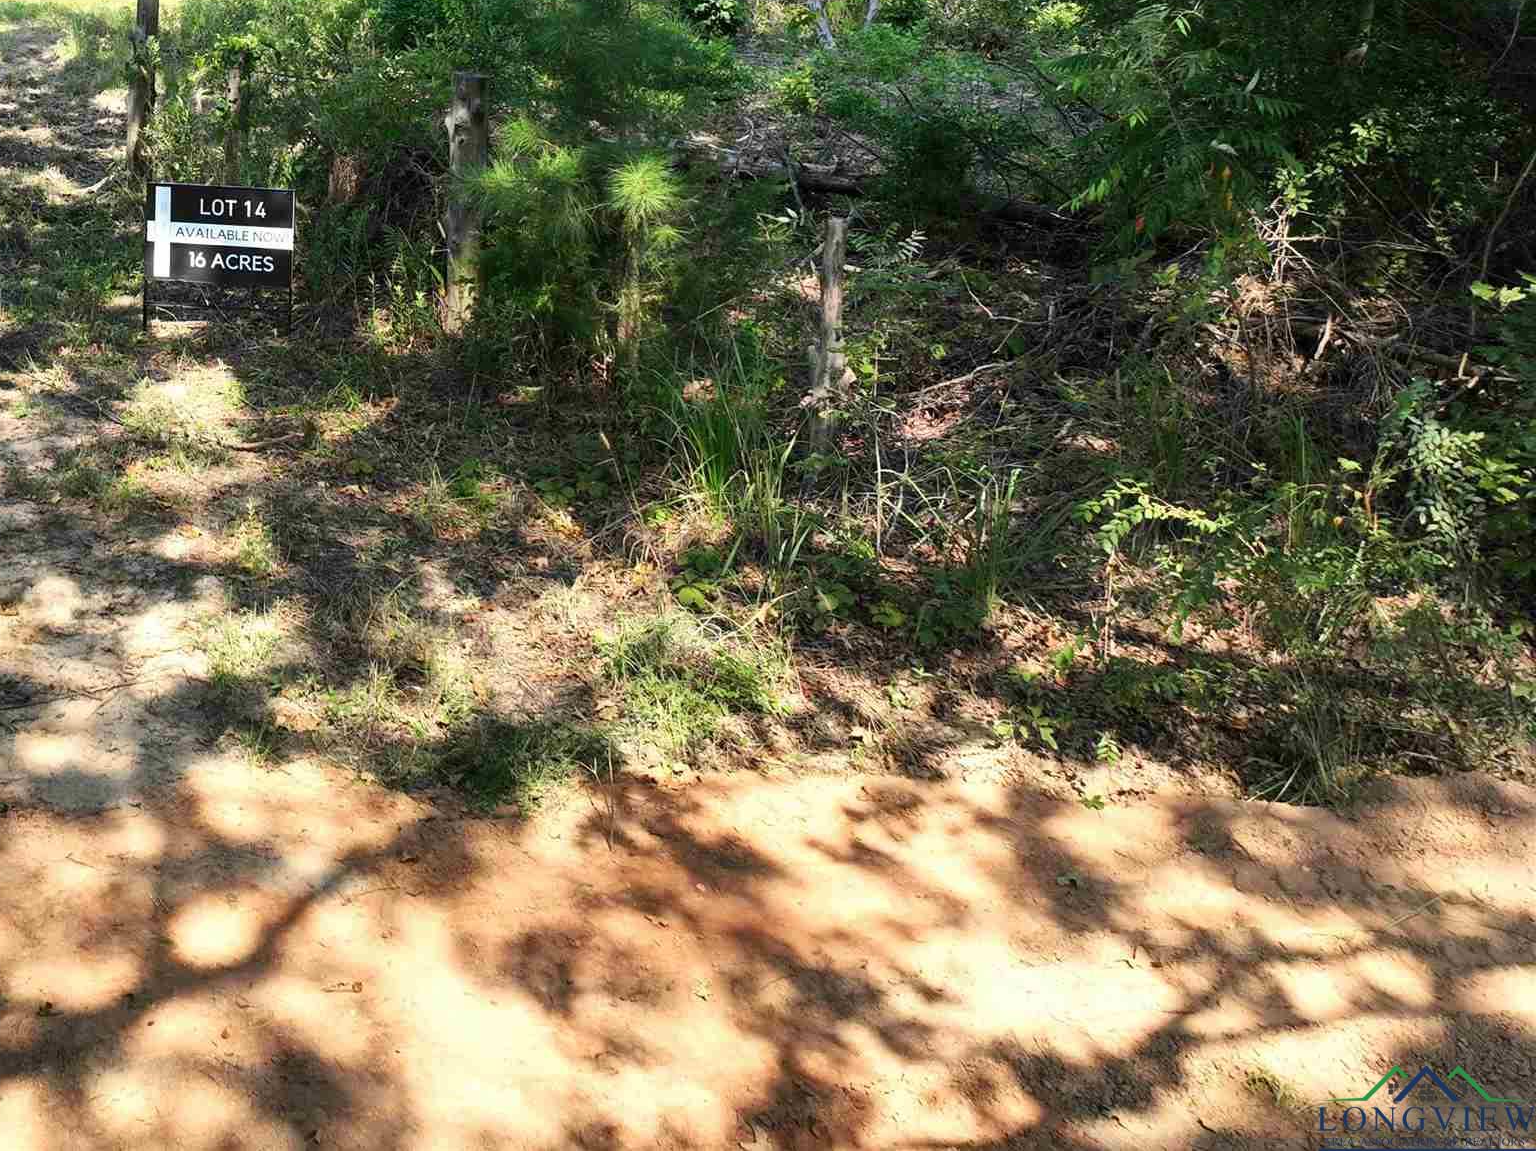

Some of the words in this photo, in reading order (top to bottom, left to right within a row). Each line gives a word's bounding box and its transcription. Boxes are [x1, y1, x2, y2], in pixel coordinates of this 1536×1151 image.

[199, 198, 237, 216] LOT
[244, 200, 267, 218] 14
[175, 226, 249, 242] AVAILABLE
[188, 250, 207, 268] 16
[210, 253, 275, 272] ACRES
